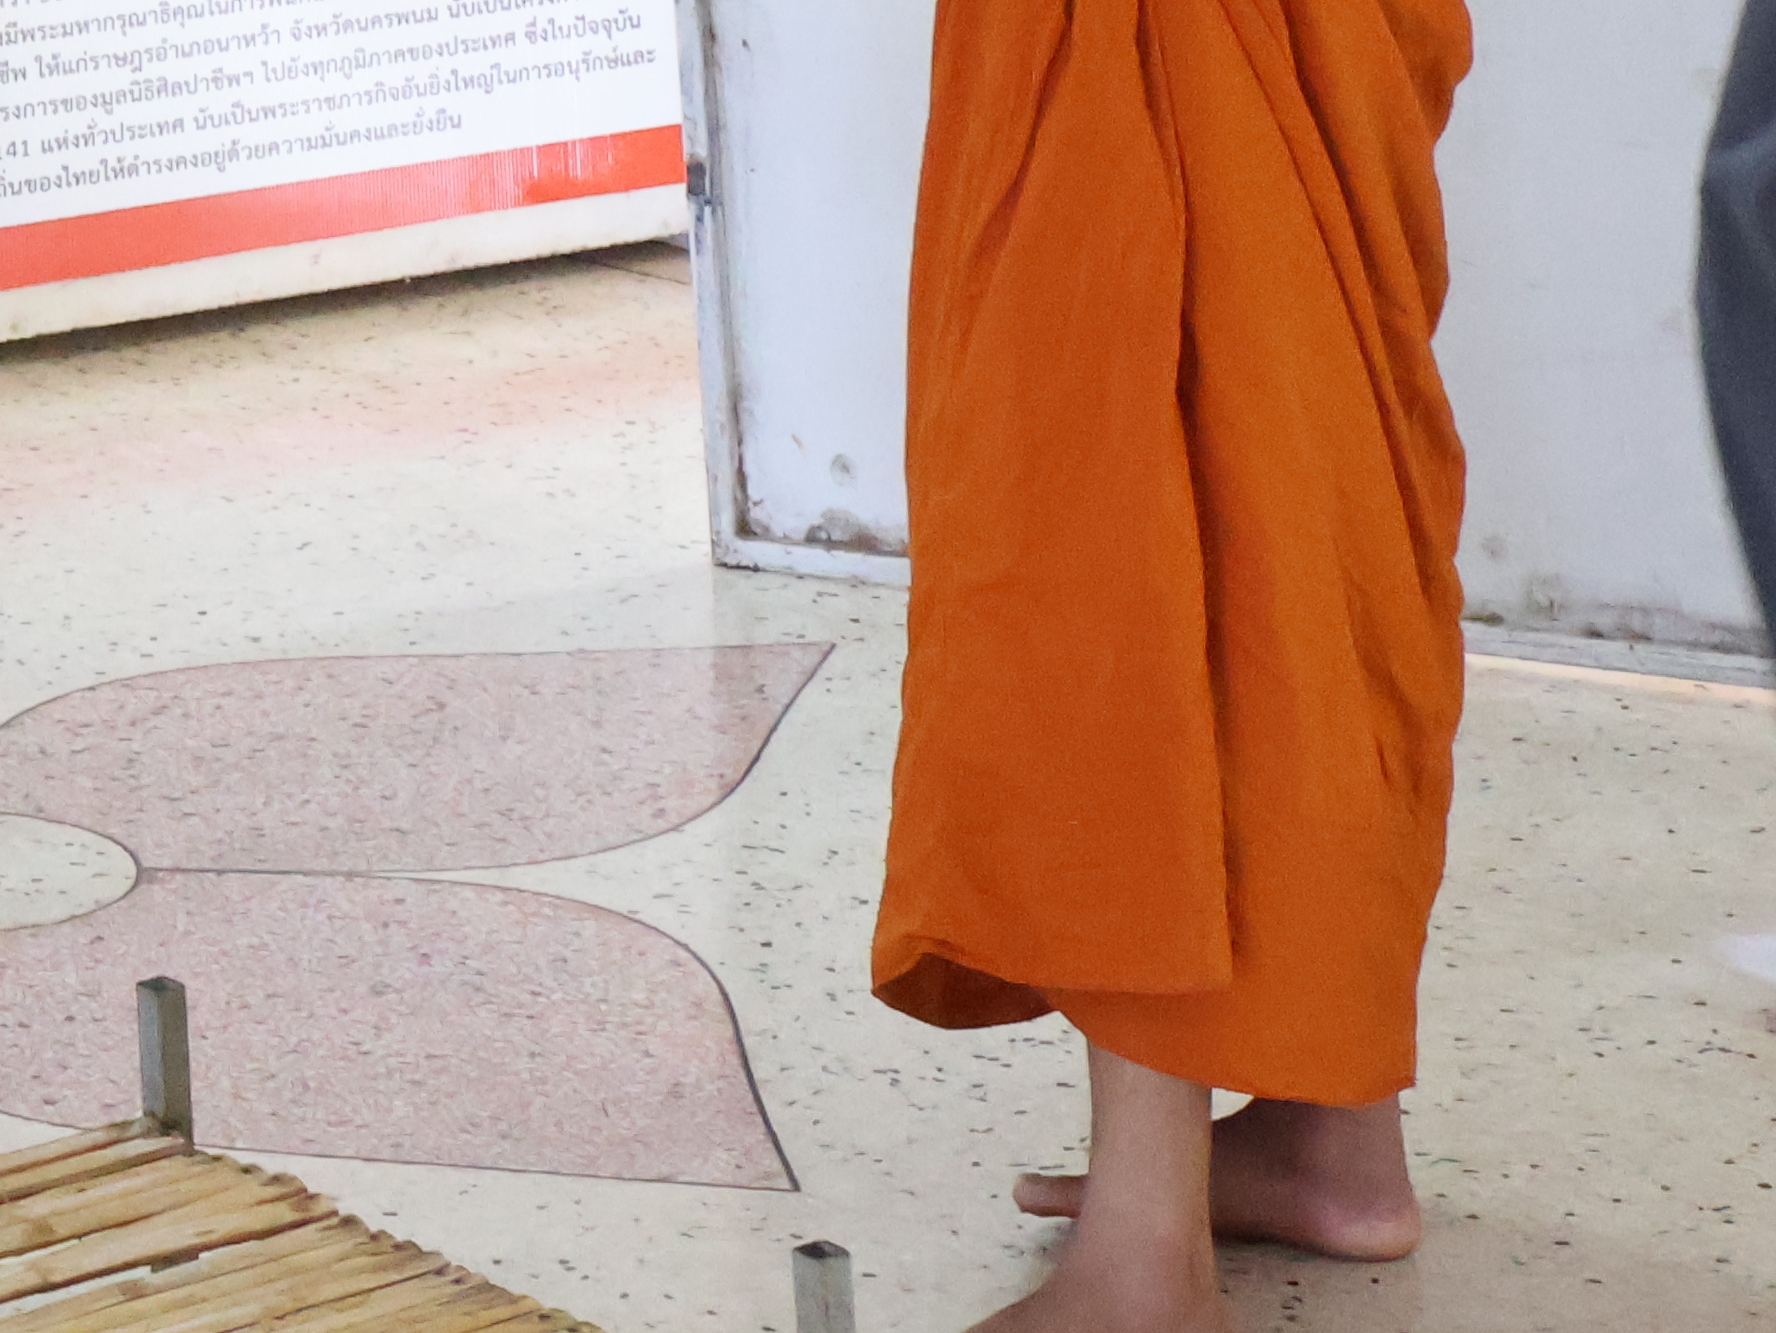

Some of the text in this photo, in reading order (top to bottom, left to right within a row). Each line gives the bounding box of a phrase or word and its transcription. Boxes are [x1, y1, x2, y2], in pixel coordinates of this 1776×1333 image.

[288, 6, 439, 42] จังหวัดนครพนม
